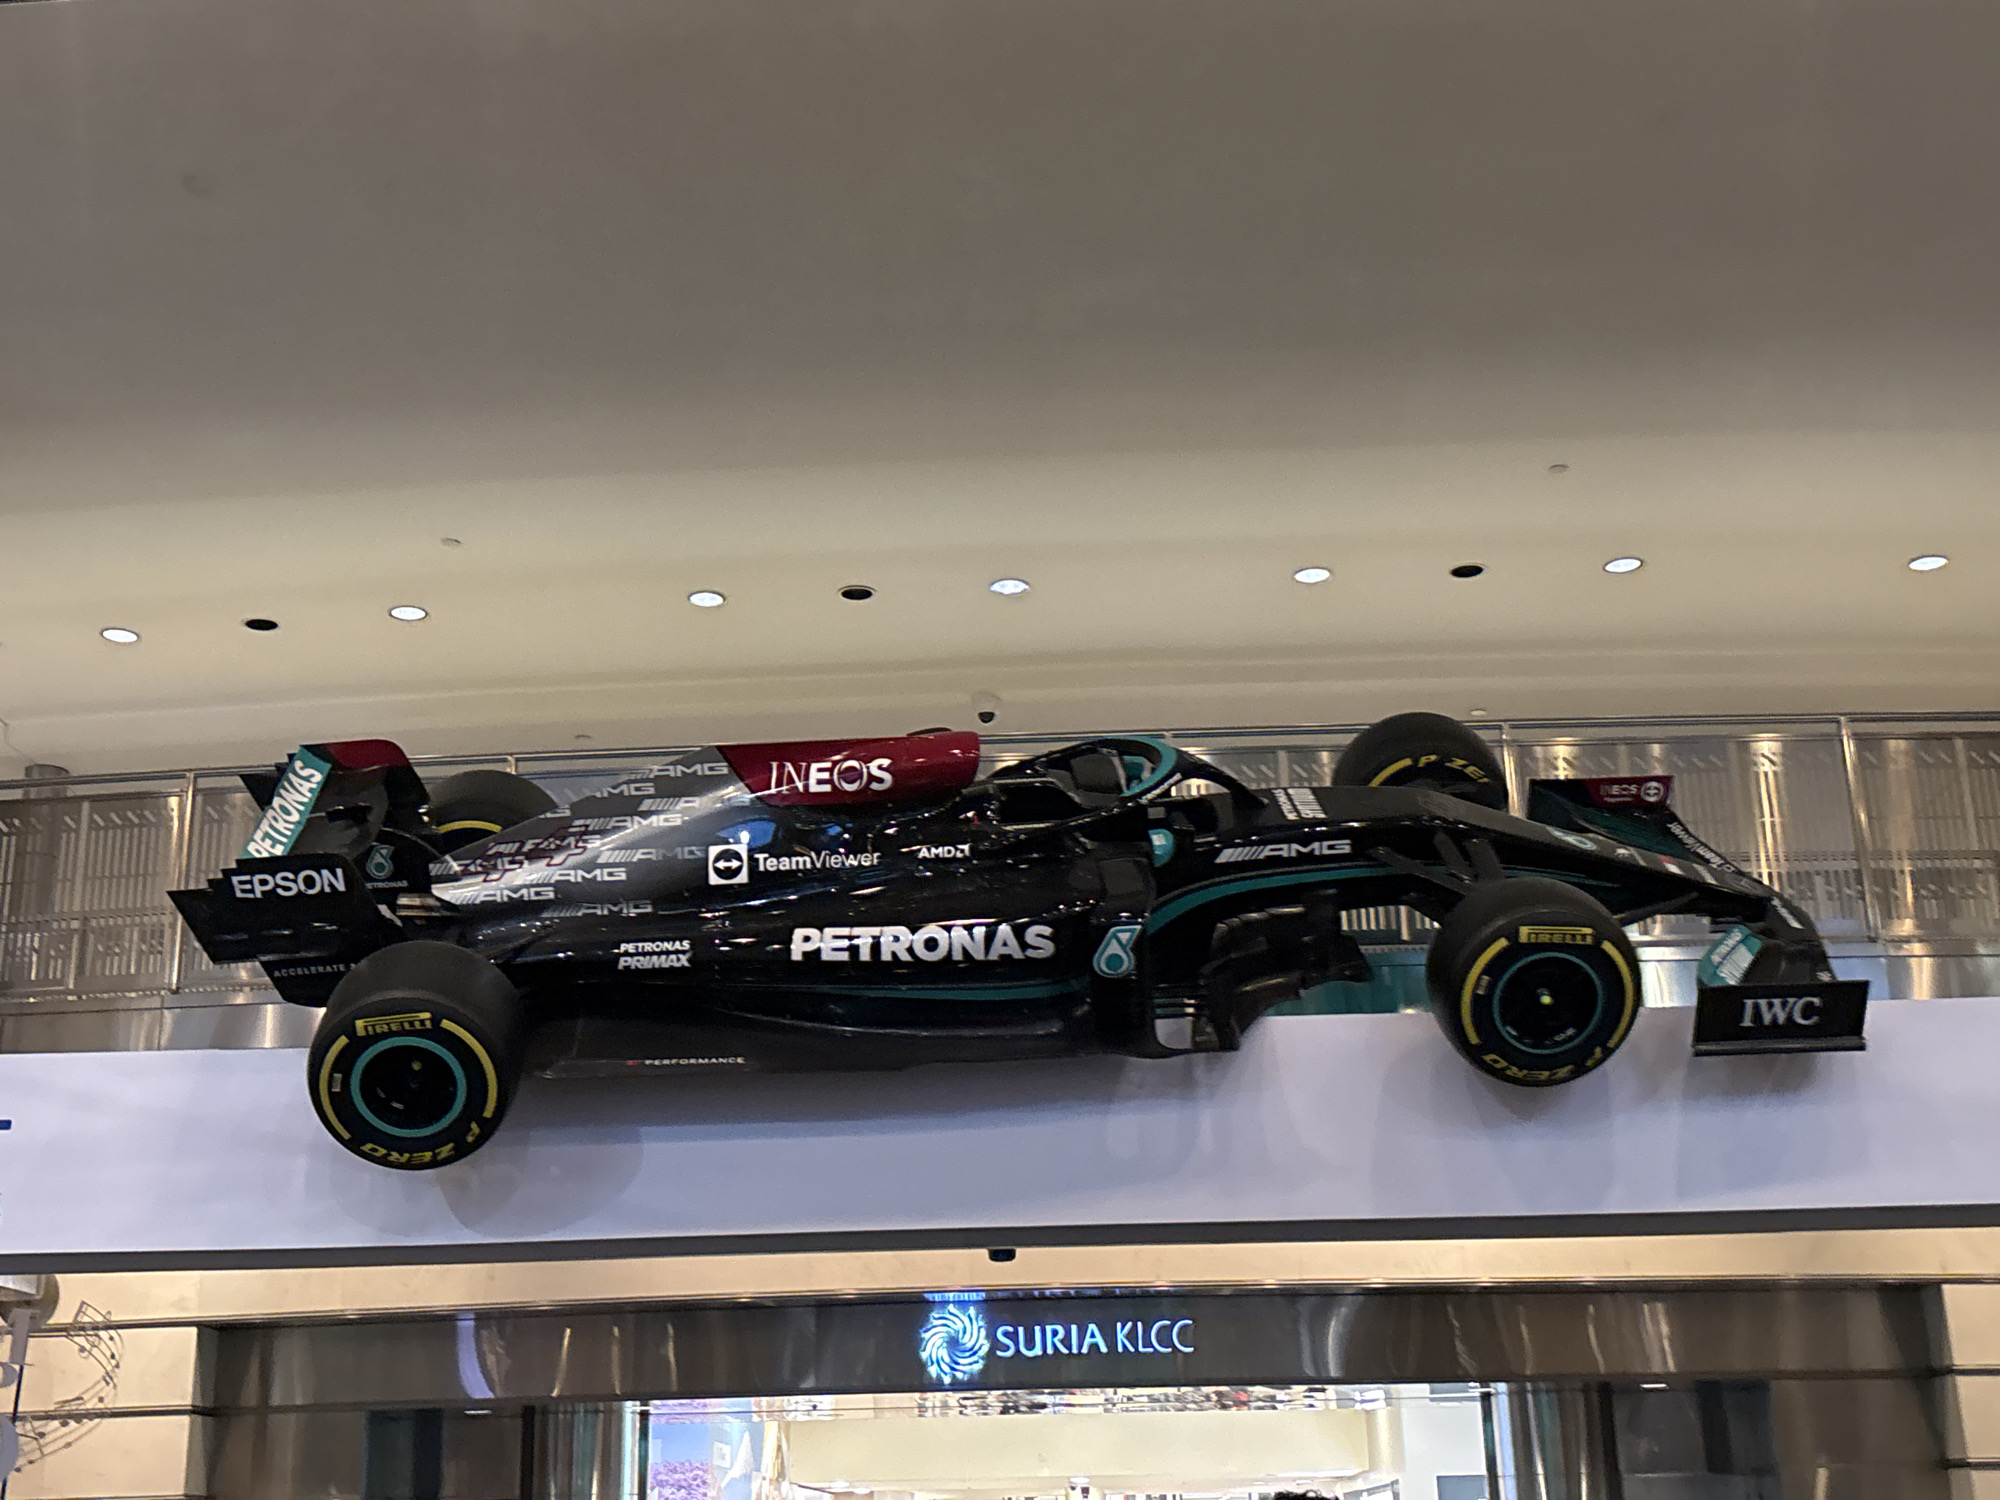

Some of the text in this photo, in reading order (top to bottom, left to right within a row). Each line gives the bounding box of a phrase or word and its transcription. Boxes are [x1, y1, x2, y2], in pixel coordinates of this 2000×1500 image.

[650, 762, 729, 778] AMG
[769, 757, 893, 794] INEOS
[247, 760, 324, 858] PETRONAS
[606, 814, 682, 830] AMG
[634, 847, 705, 861] AMG
[917, 845, 956, 859] AMD
[1258, 840, 1352, 857] AMG
[754, 850, 882, 872] TeamViewer
[231, 868, 347, 898] EPSON
[551, 867, 626, 883] AMG
[479, 886, 555, 902] AMG
[580, 900, 653, 917] AMG
[789, 923, 1056, 962] PETRONAS
[1518, 926, 1594, 945] PIRELLI
[619, 940, 691, 953] PETRONAS
[617, 952, 694, 970] PRIMAX
[274, 963, 345, 978] ACCELERATE
[1739, 996, 1822, 1028] IWC
[355, 1012, 432, 1037] PIRELLI
[644, 1057, 746, 1066] PERFORMANCE
[360, 1142, 455, 1164] ZERO
[995, 1318, 1194, 1357] SURIA KLCC
